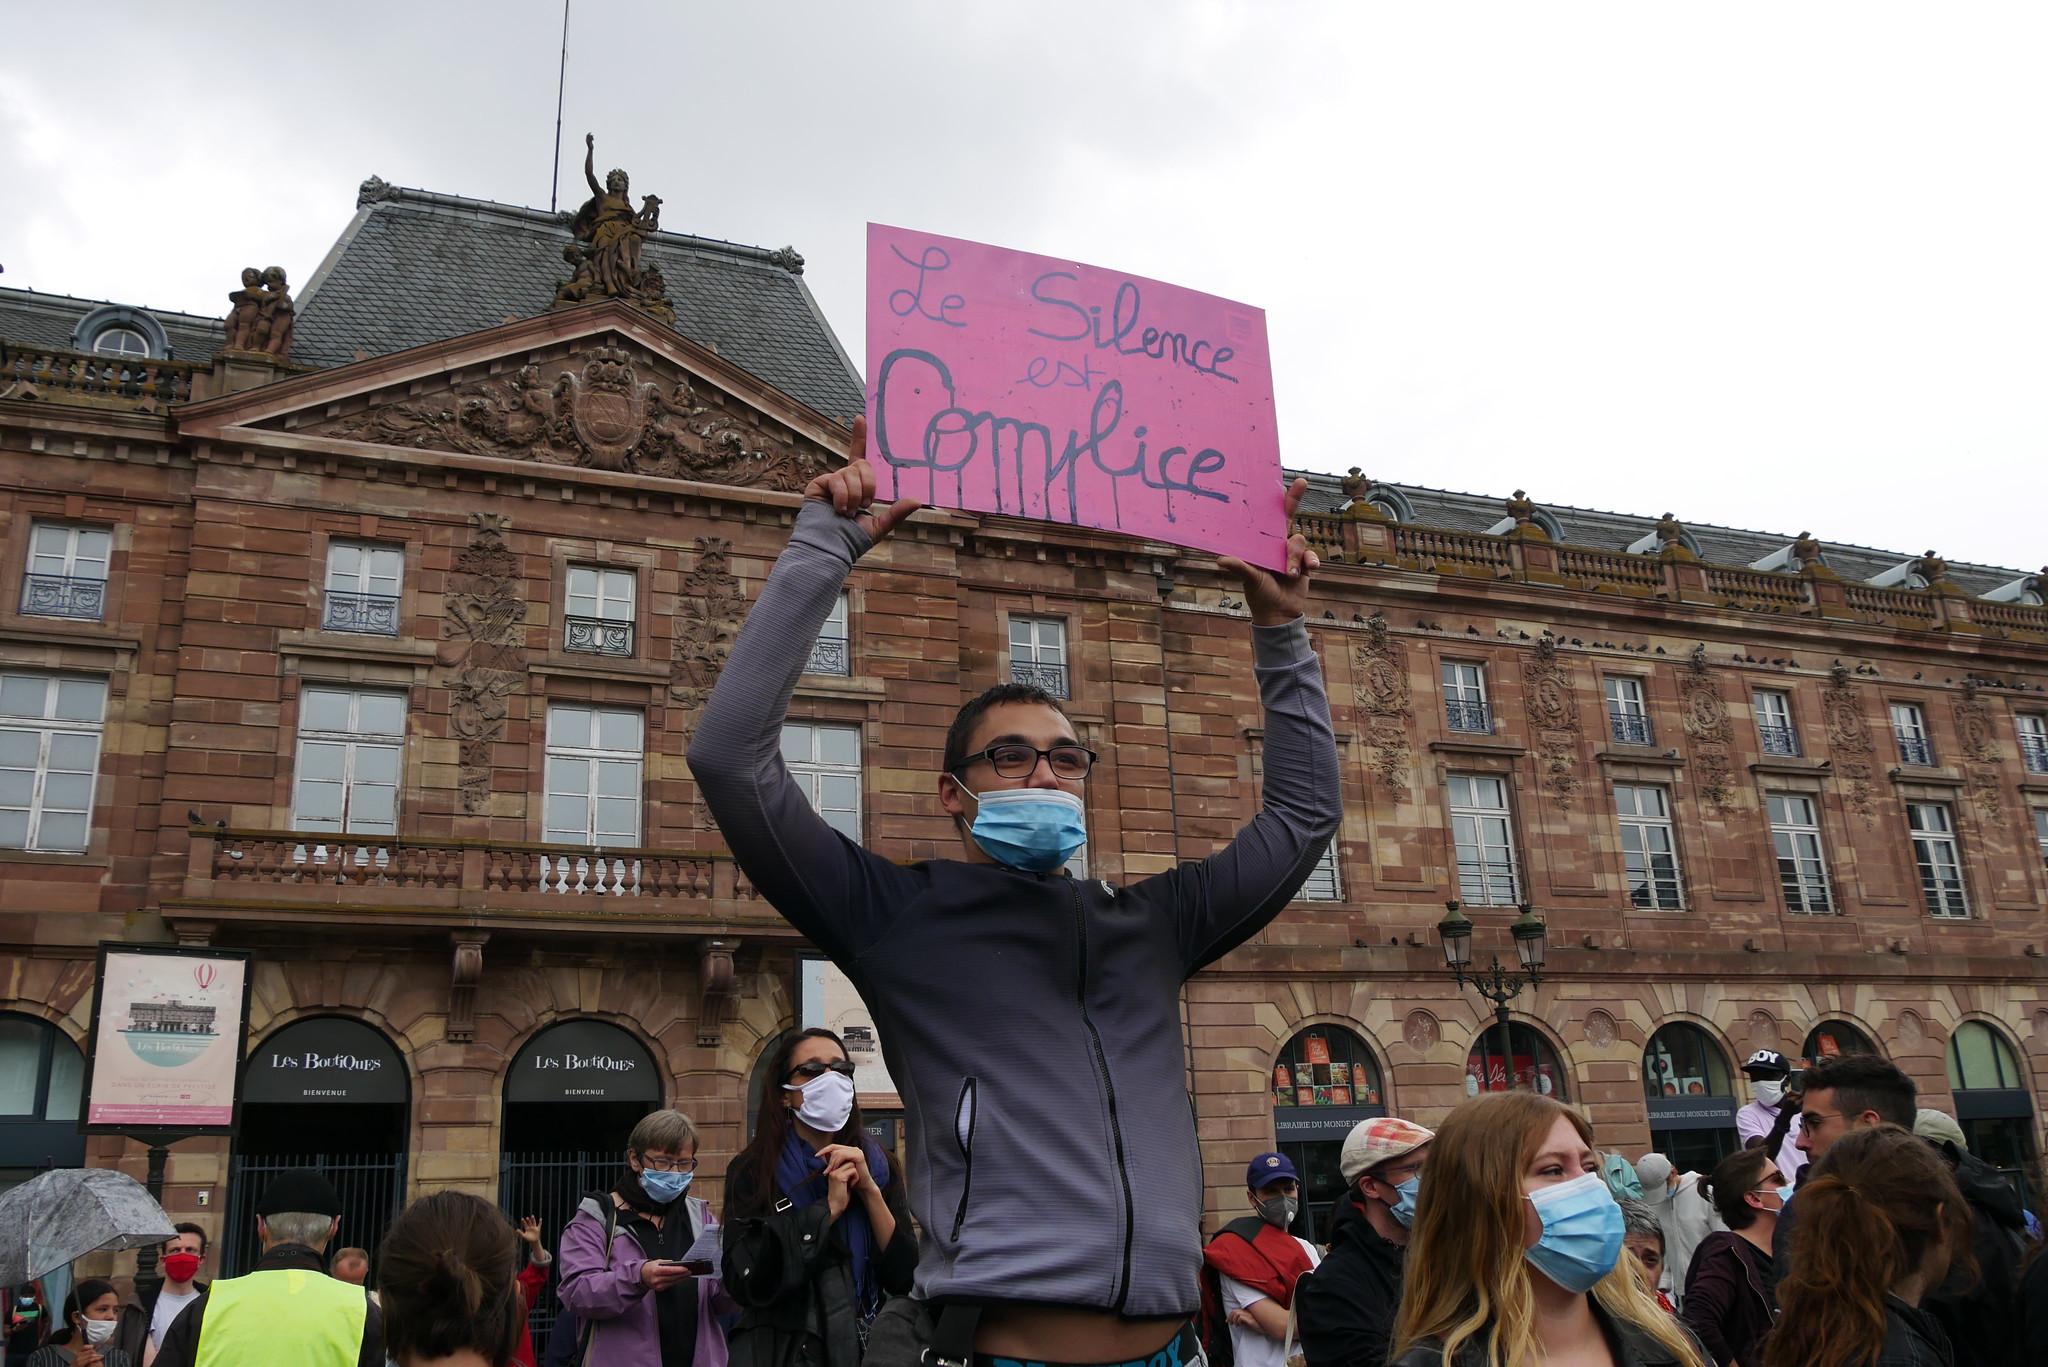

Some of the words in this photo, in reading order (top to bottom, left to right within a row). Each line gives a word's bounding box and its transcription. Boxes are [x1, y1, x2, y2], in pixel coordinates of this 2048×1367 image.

[890, 244, 967, 327] Le
[1028, 272, 1238, 384] Silence
[1015, 355, 1107, 392] est
[876, 349, 1230, 522] Complice
[271, 1054, 298, 1067] Les
[536, 1056, 559, 1068] Les
[1748, 1049, 1779, 1064] BOY
[1648, 1111, 1676, 1119] LIBRAIRIE
[1677, 1110, 1686, 1118] DU
[1710, 1109, 1731, 1117] ENTIER
[1276, 1121, 1310, 1129] LIBRAIRIE
[1311, 1121, 1322, 1129] DU
[1324, 1120, 1351, 1128] MONDE
